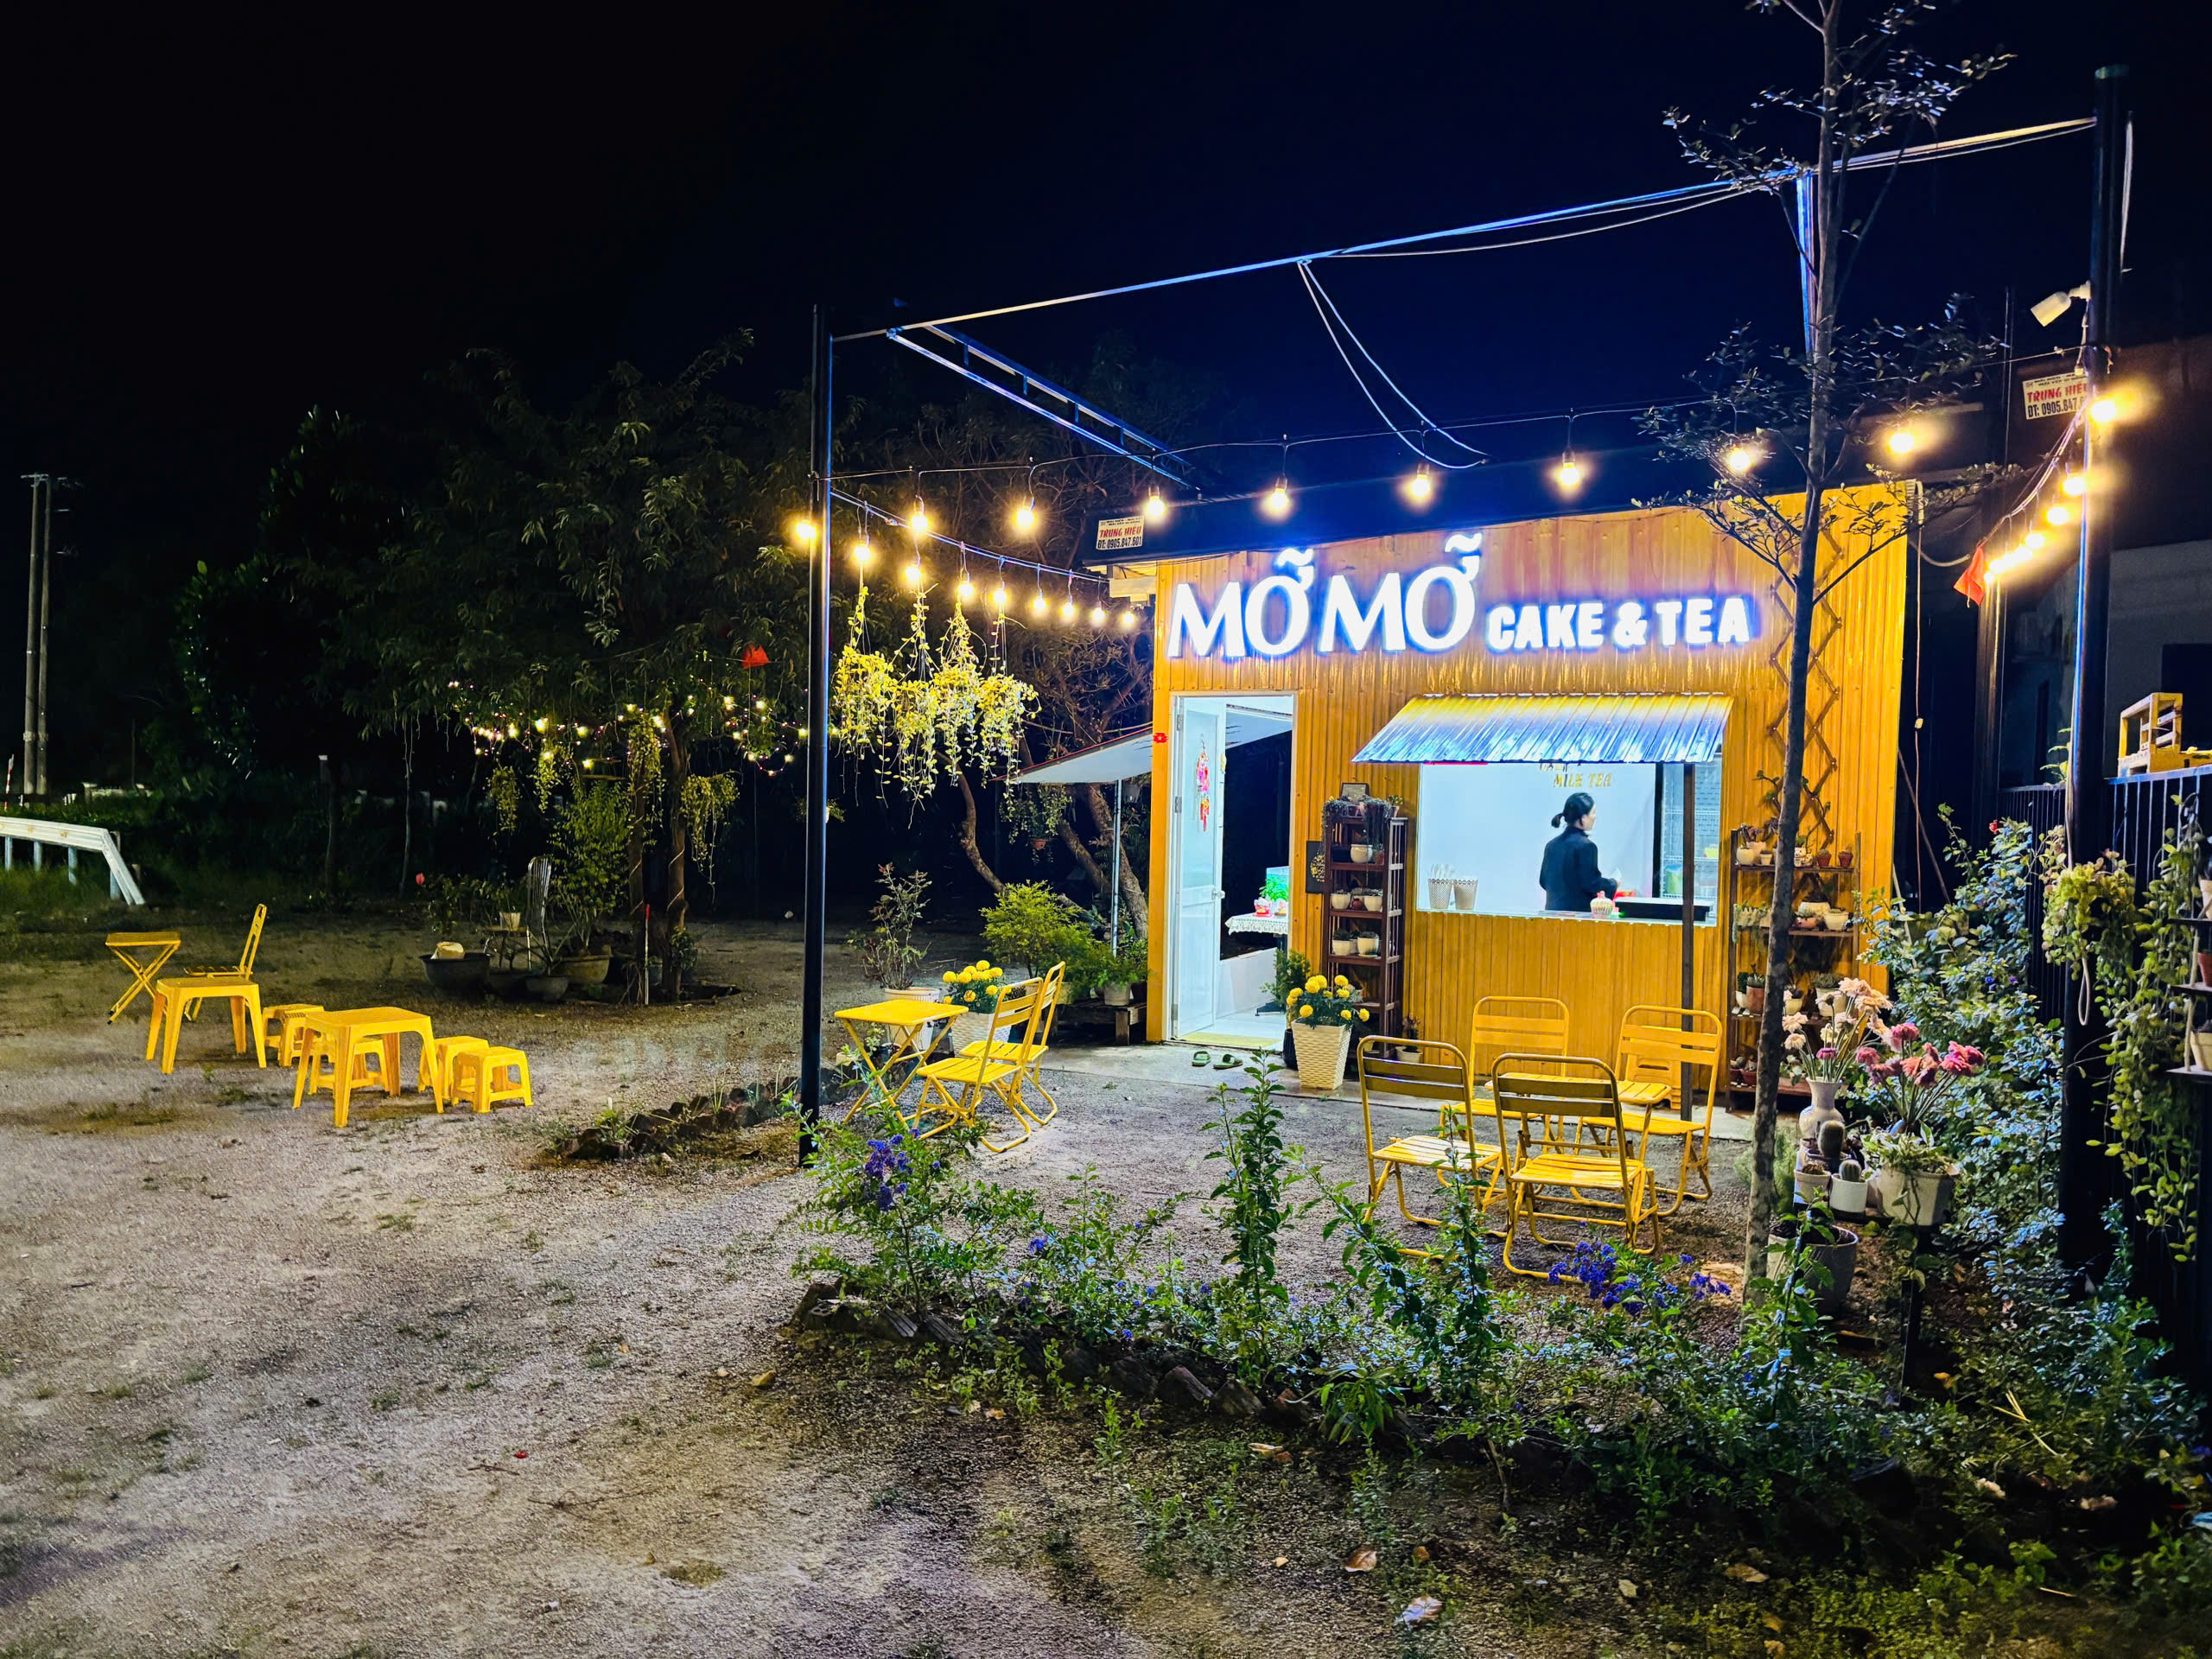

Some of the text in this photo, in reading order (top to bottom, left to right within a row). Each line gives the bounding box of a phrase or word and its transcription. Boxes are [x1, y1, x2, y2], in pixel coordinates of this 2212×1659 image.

[2027, 387, 2062, 402] TRUNG
[1099, 528, 1122, 537] TRUNG
[1487, 601, 1604, 650] CAKE
[1613, 602, 1648, 647] &
[1656, 598, 1751, 644] TEA
[1554, 773, 1611, 788] MILK TEA
